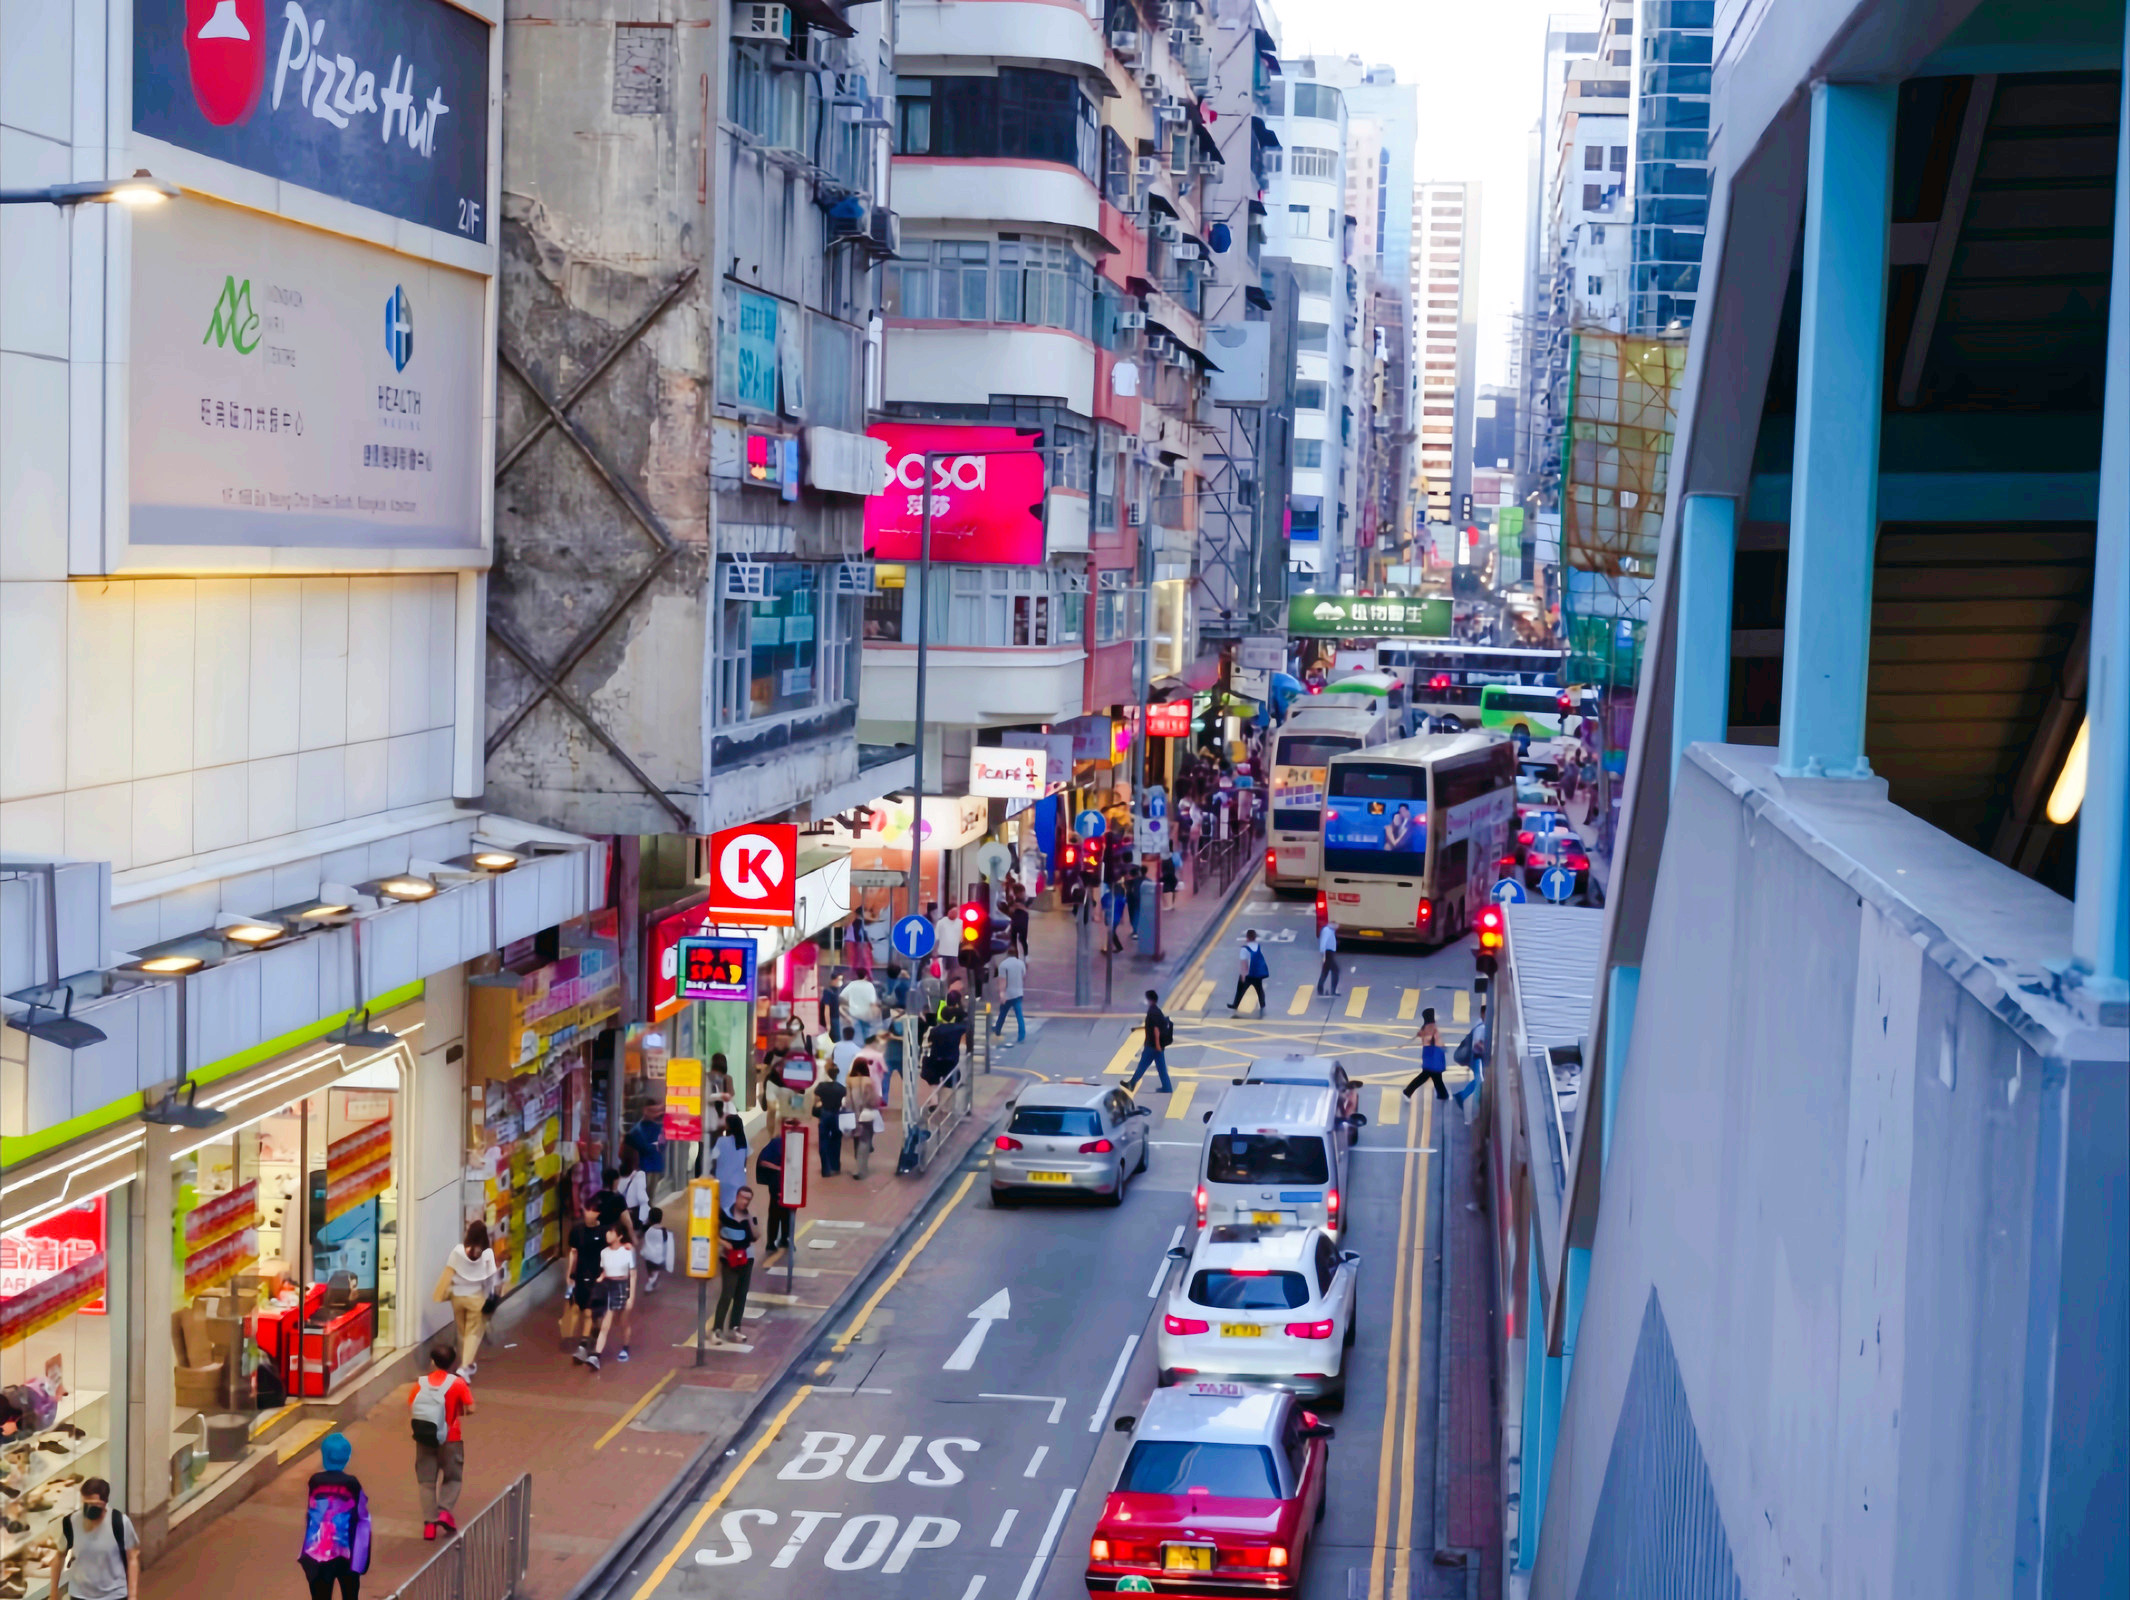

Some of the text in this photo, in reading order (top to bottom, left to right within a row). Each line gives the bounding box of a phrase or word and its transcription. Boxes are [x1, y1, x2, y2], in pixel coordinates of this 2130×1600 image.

[272, 1, 450, 158] Pizza Hut
[690, 963, 727, 981] SPA
[1195, 1383, 1238, 1395] TAXI
[776, 1431, 981, 1486] BUS
[695, 1509, 962, 1574] STOP
